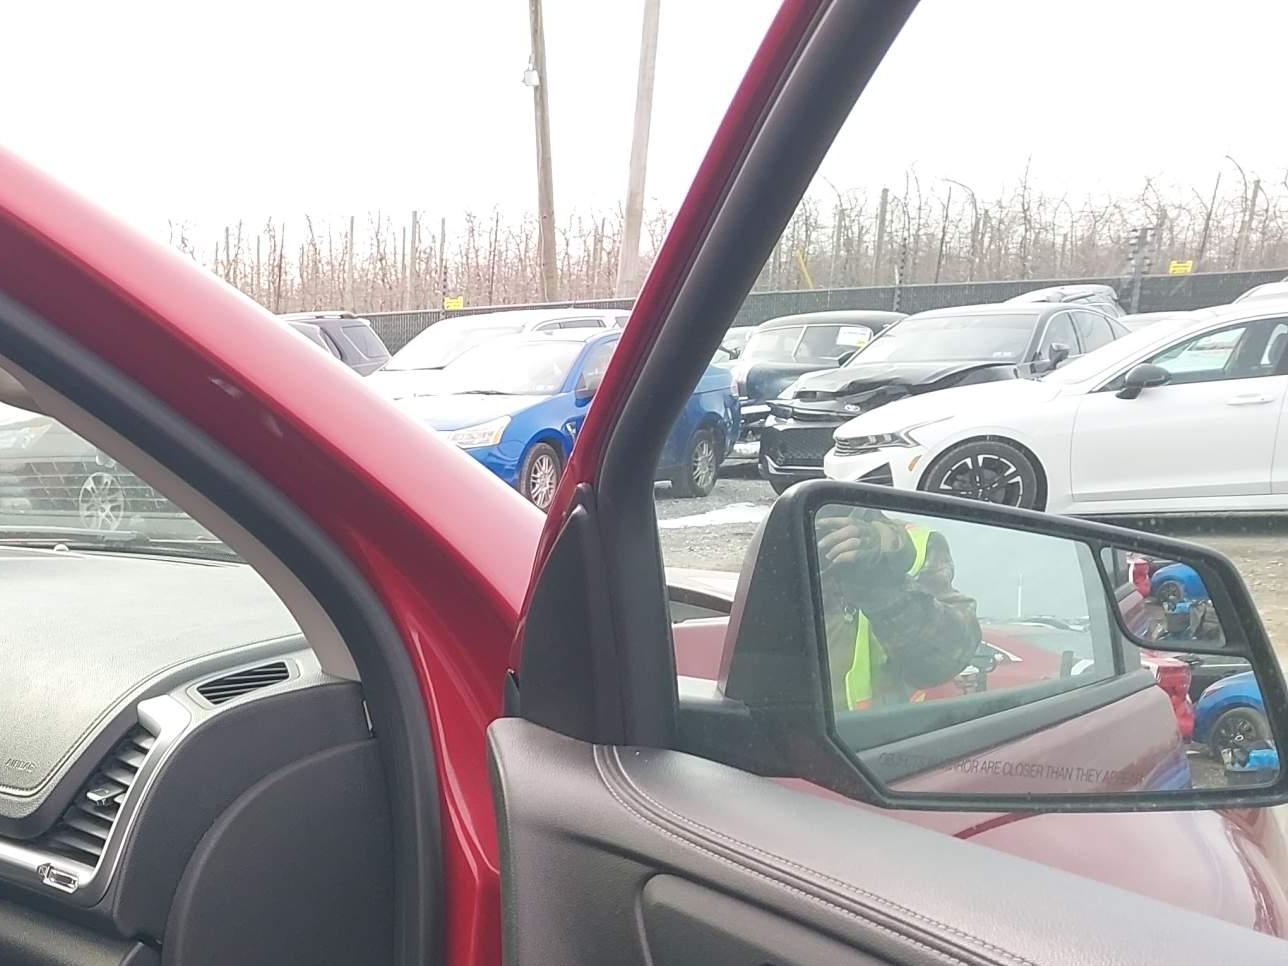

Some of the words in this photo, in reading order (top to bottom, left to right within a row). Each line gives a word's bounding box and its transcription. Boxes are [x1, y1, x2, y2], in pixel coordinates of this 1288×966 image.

[980, 758, 1002, 775] ARE
[1002, 761, 1044, 780] CLOSER
[1044, 765, 1073, 781] THAN
[1074, 767, 1103, 783] THEY
